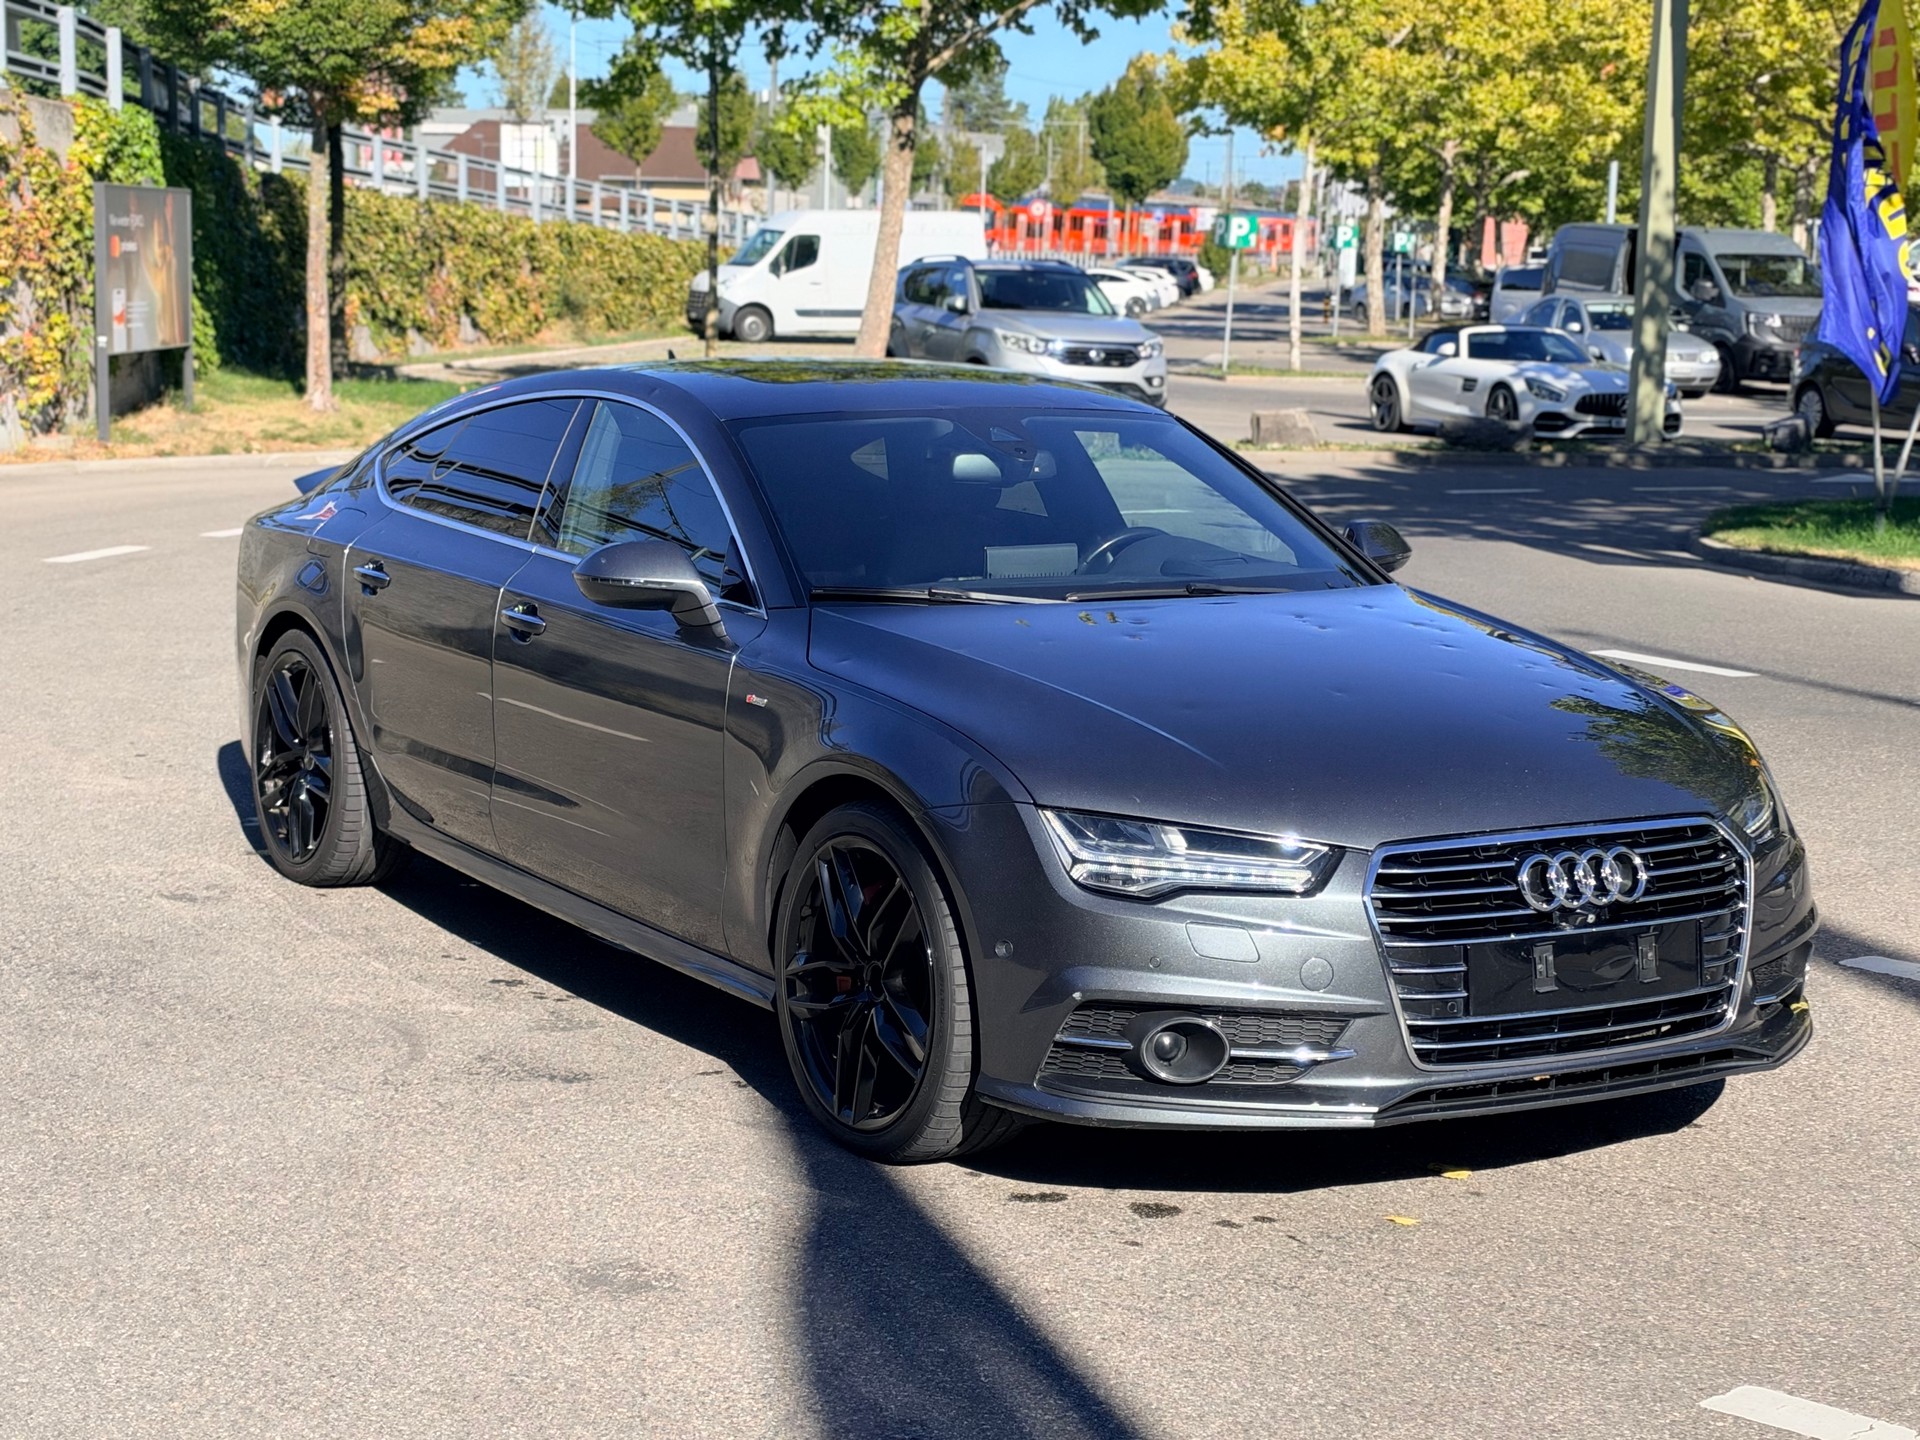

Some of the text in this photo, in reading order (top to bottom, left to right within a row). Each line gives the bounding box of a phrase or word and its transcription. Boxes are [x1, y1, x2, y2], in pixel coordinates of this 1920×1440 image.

[1228, 216, 1251, 247] P
[1337, 225, 1353, 248] P
[1394, 232, 1408, 252] P
